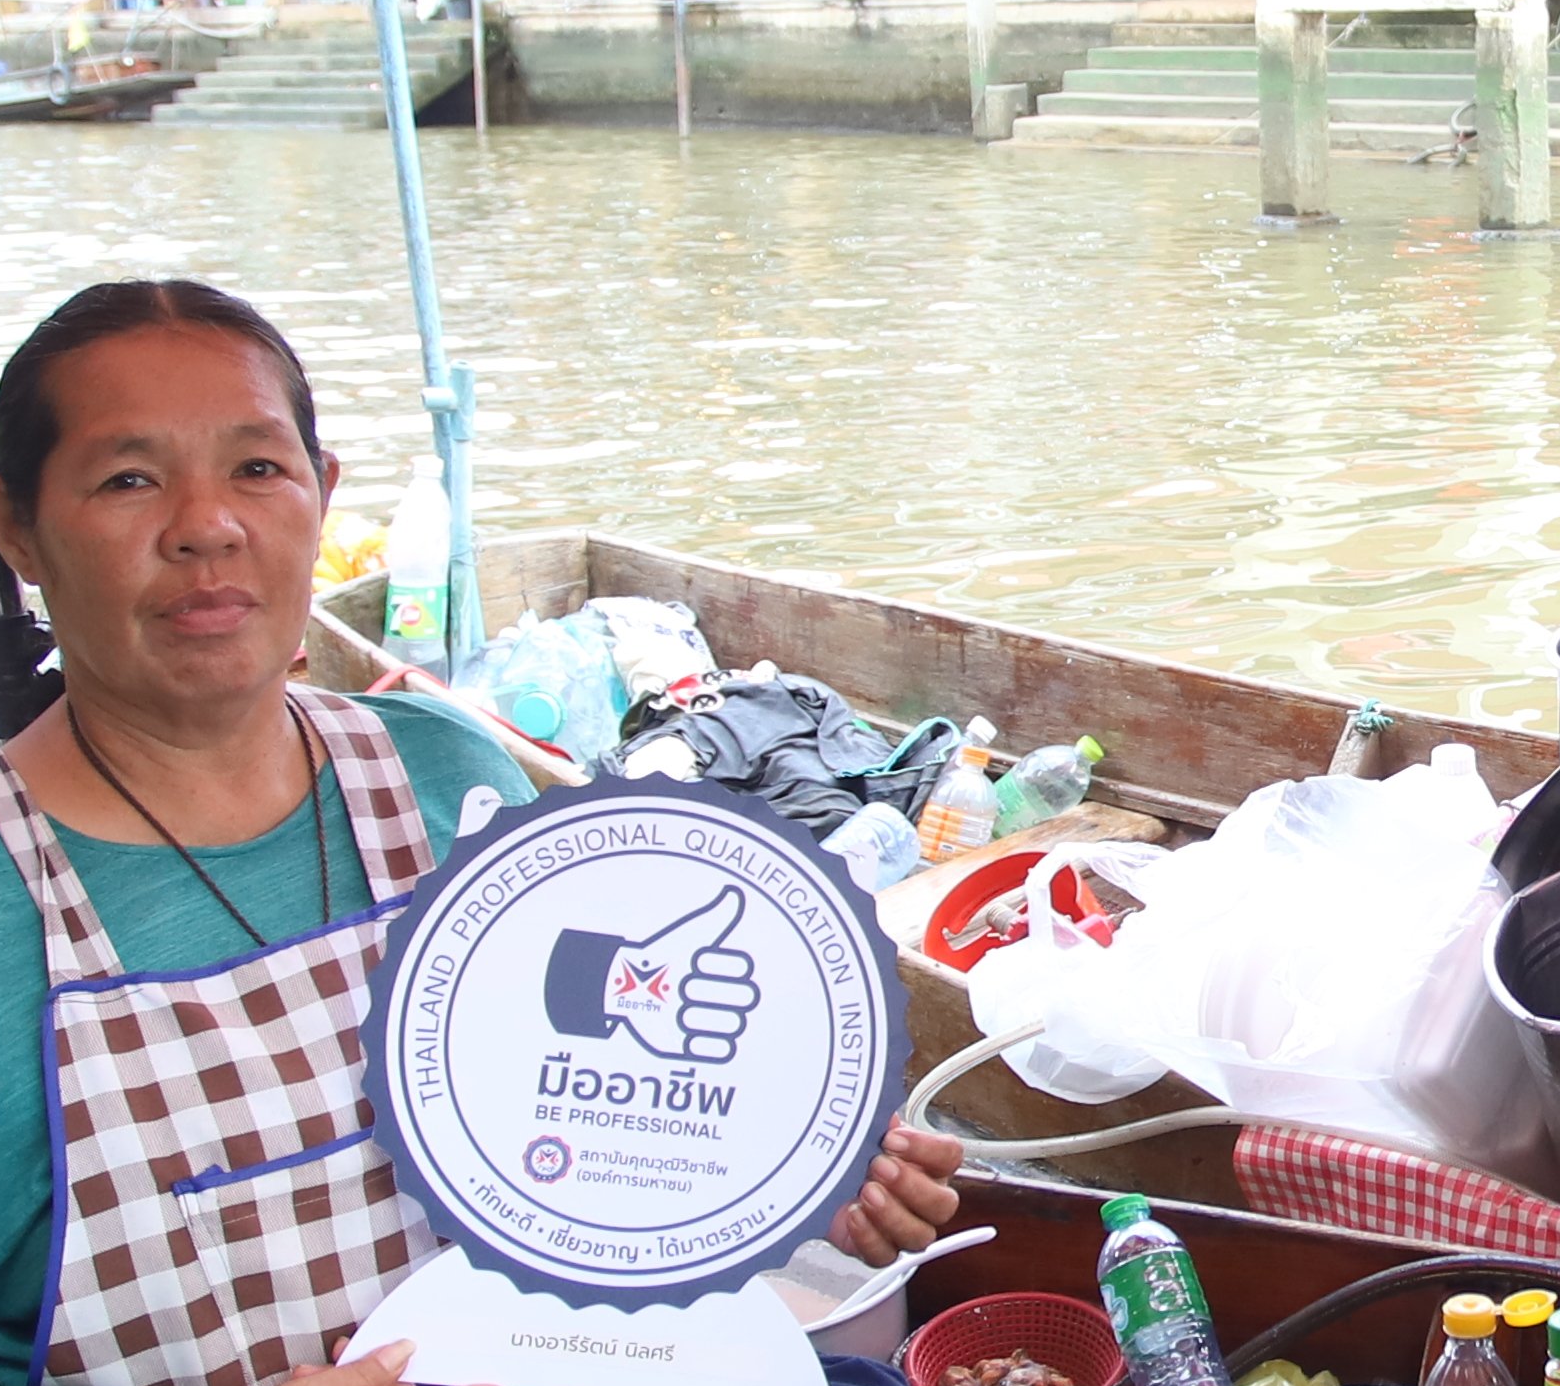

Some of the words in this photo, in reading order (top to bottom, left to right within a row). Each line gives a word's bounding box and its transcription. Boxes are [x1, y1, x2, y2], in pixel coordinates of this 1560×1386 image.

[415, 952, 457, 1109] THAILAND
[451, 821, 666, 944] PROFESSIONAL
[684, 827, 855, 986] QUALIFICATION
[810, 1000, 864, 1158] INSTITUTE
[616, 994, 662, 1014] มืออาชีพ
[537, 1051, 737, 1117] มืออาชีพ
[534, 1104, 563, 1122] BE
[568, 1108, 723, 1141] PROFESSIONAL
[576, 1167, 693, 1194] (องค์การมหาชน)
[578, 1149, 729, 1177] สถาบันคุณวุฒิวิชาชีพ
[473, 1182, 538, 1234] ทักษะดี
[547, 1224, 640, 1264] เชี่ยวชาญ
[656, 1206, 768, 1260] ได้มาตรฐาน
[510, 1330, 619, 1358] นางอารีรัตน์
[624, 1338, 677, 1363] นิลศรี
